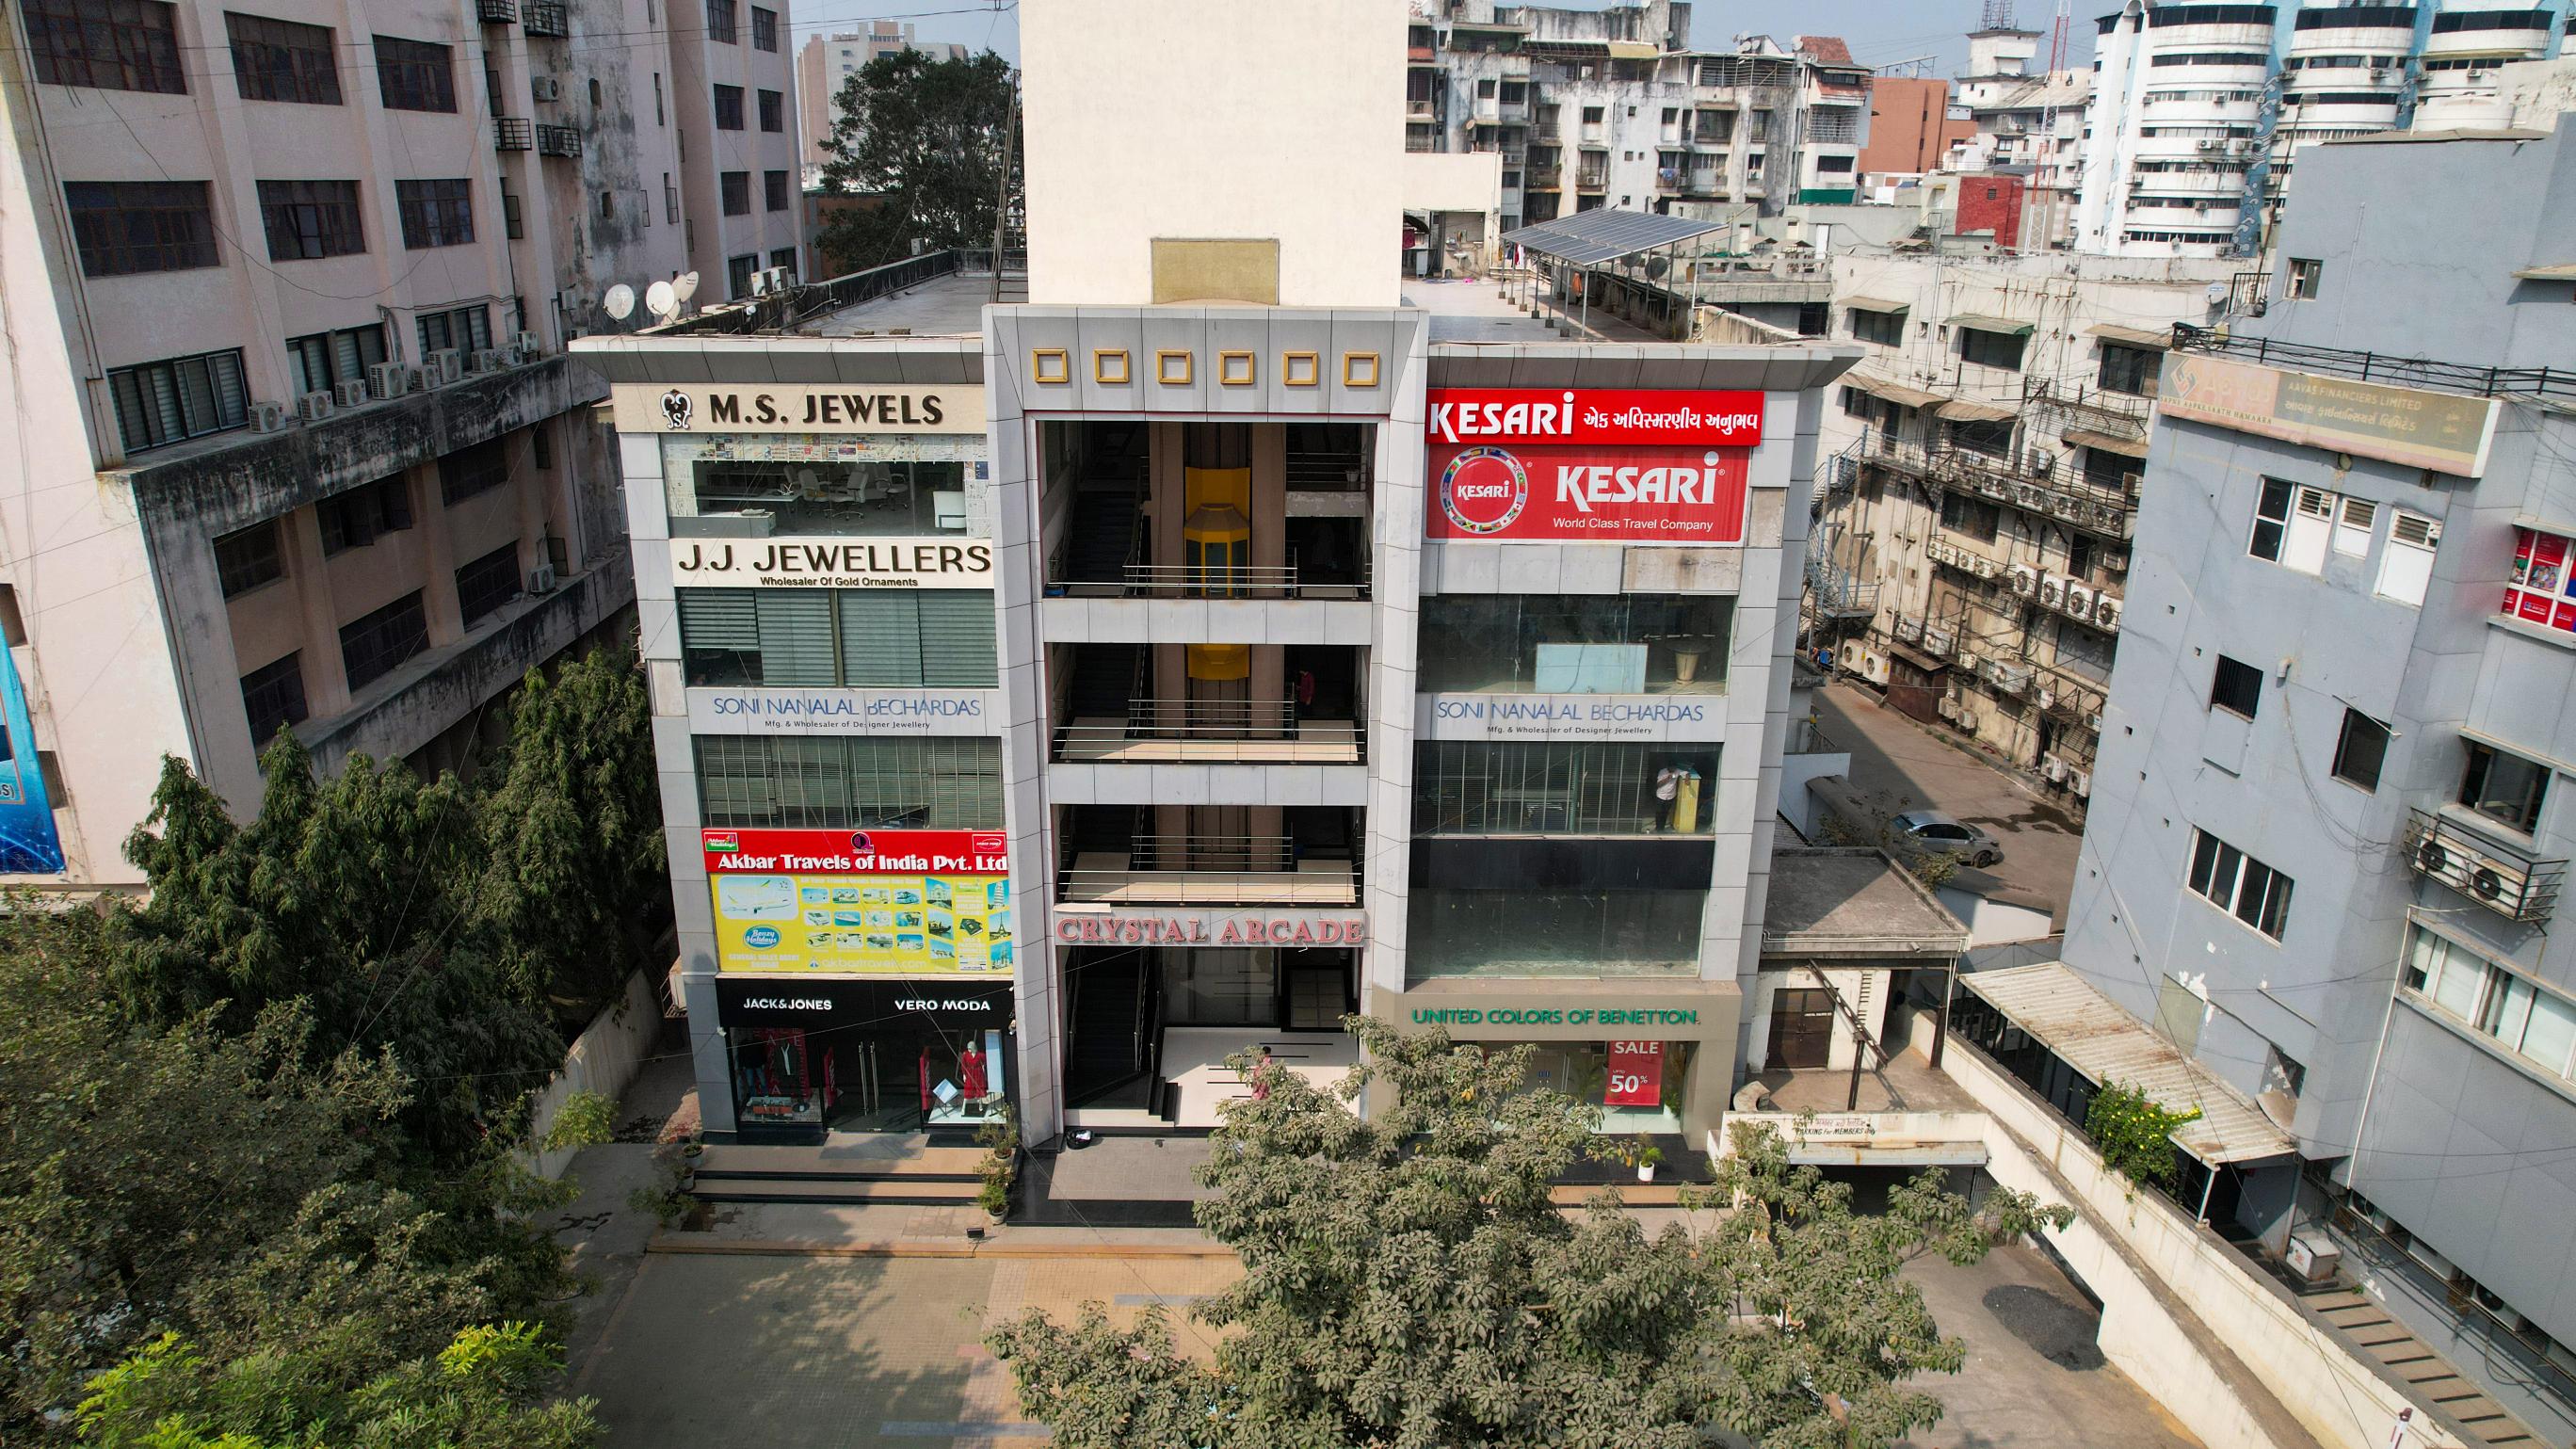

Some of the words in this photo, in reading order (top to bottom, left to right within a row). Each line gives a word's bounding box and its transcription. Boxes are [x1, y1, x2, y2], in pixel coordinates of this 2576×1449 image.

[2287, 381, 2317, 395] AAVAS
[2319, 386, 2377, 406] FINANCIERS
[2379, 394, 2423, 411] LIMITED
[710, 394, 789, 424] M.S.
[802, 394, 942, 426] JEWELS
[1584, 406, 1609, 427] એક
[1705, 411, 1759, 435] અનુભવ
[1553, 518, 1586, 529] World
[1588, 518, 1620, 529] Class
[1623, 518, 1657, 529] Travel
[1660, 519, 1714, 532] Company
[678, 544, 740, 572] J.J.
[753, 544, 991, 572] JEWELLERS
[760, 576, 817, 586] Wholesaler
[820, 576, 832, 586] Of
[834, 576, 859, 586] Gold
[861, 576, 918, 586] Ornaments
[714, 698, 759, 715] SONI
[767, 699, 860, 716] NANALAL
[867, 699, 980, 716] BECHARDAS
[1438, 701, 1484, 718] SONI
[1491, 702, 1583, 720] NANALAL
[1591, 704, 1704, 722] BECHARDAS
[765, 720, 782, 729] Mfg.
[853, 721, 890, 730] Designer
[1487, 726, 1505, 734] Mfg.
[1575, 726, 1612, 735] Designer
[1615, 727, 1652, 735] Jewellery
[0, 783, 15, 798] S)
[717, 854, 777, 869] Akbar
[781, 854, 850, 869] Travels
[855, 854, 876, 870] of
[879, 855, 928, 870] India
[933, 855, 972, 871] Pvt.
[975, 855, 1007, 870] Ltd
[1056, 918, 1211, 942] CRYSTAL
[1219, 918, 1364, 944] ARCADE
[743, 998, 832, 1010] JACK&JONES
[894, 1000, 939, 1010] VERO
[942, 1000, 990, 1010] MODA
[1411, 1008, 1483, 1024] UNITED
[1487, 1008, 1562, 1024] COLORS
[1567, 1009, 1594, 1024] OF
[1615, 1041, 1658, 1054] SALE
[1833, 1127, 1863, 1135] MEMBERS
